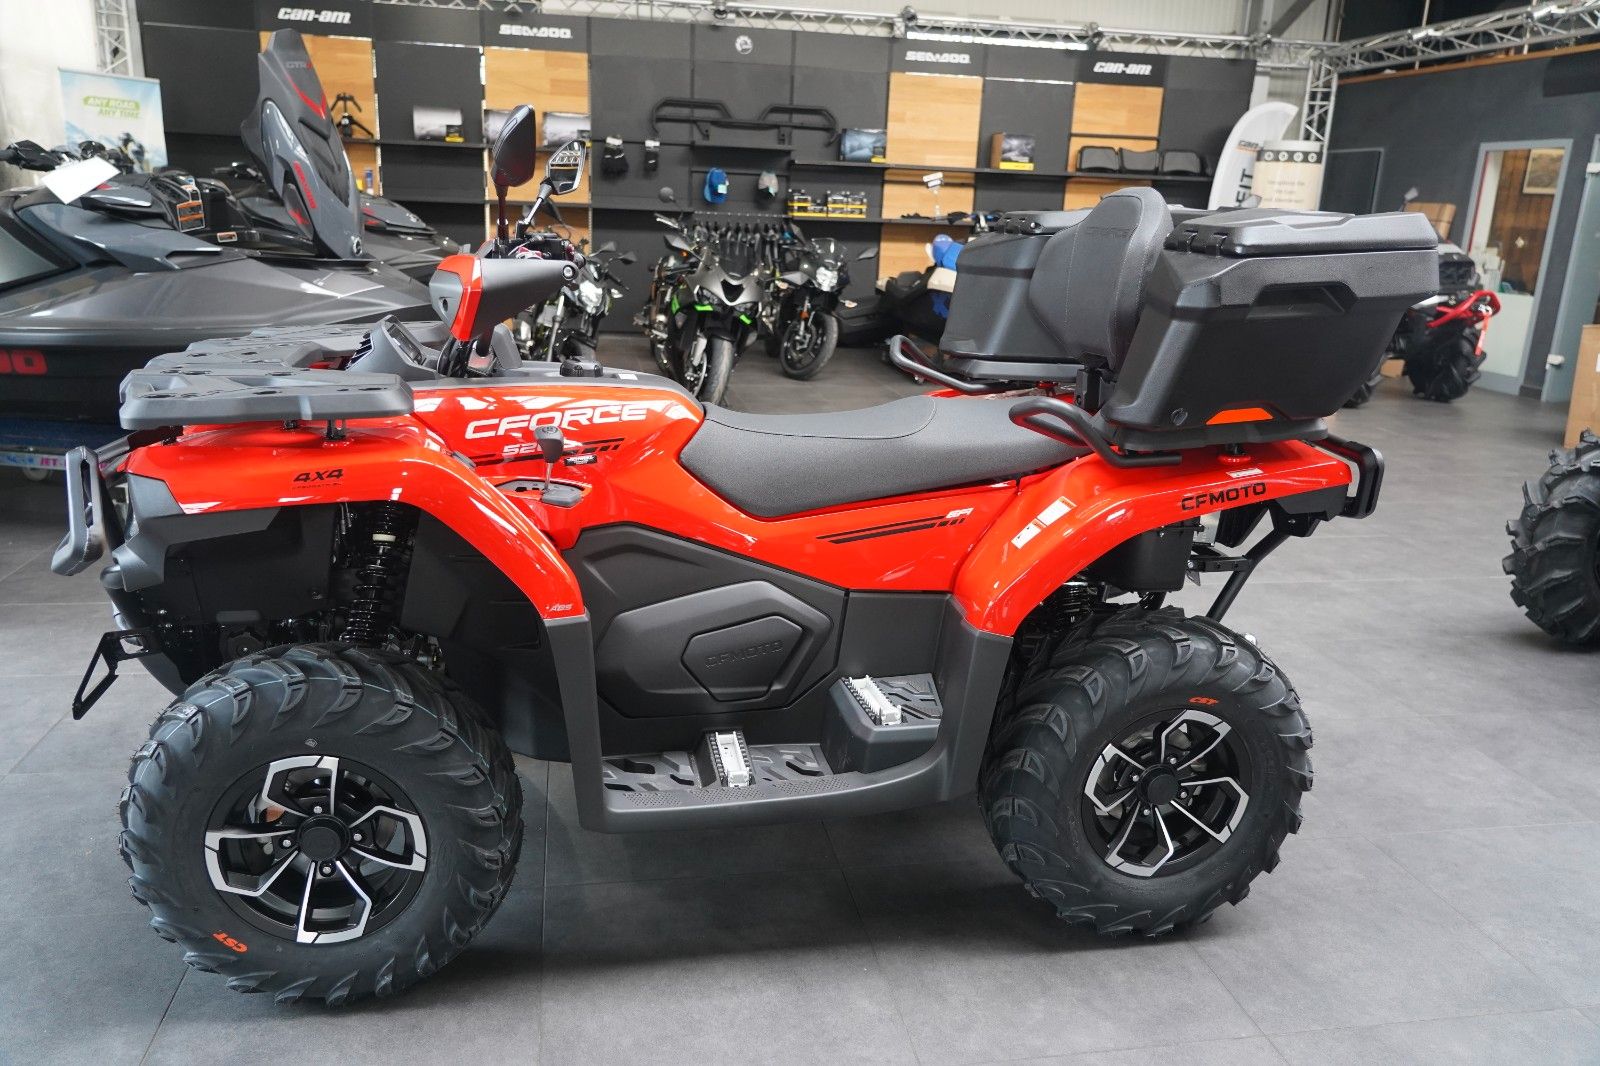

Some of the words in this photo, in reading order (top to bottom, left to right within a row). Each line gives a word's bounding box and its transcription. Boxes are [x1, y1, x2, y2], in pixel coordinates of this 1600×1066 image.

[277, 8, 351, 24] can-am
[1093, 62, 1152, 75] can-am
[465, 404, 647, 440] CFORCE
[1181, 483, 1267, 510] CFMOTO
[705, 641, 783, 669] CFMOTO
[213, 933, 248, 952] CST
